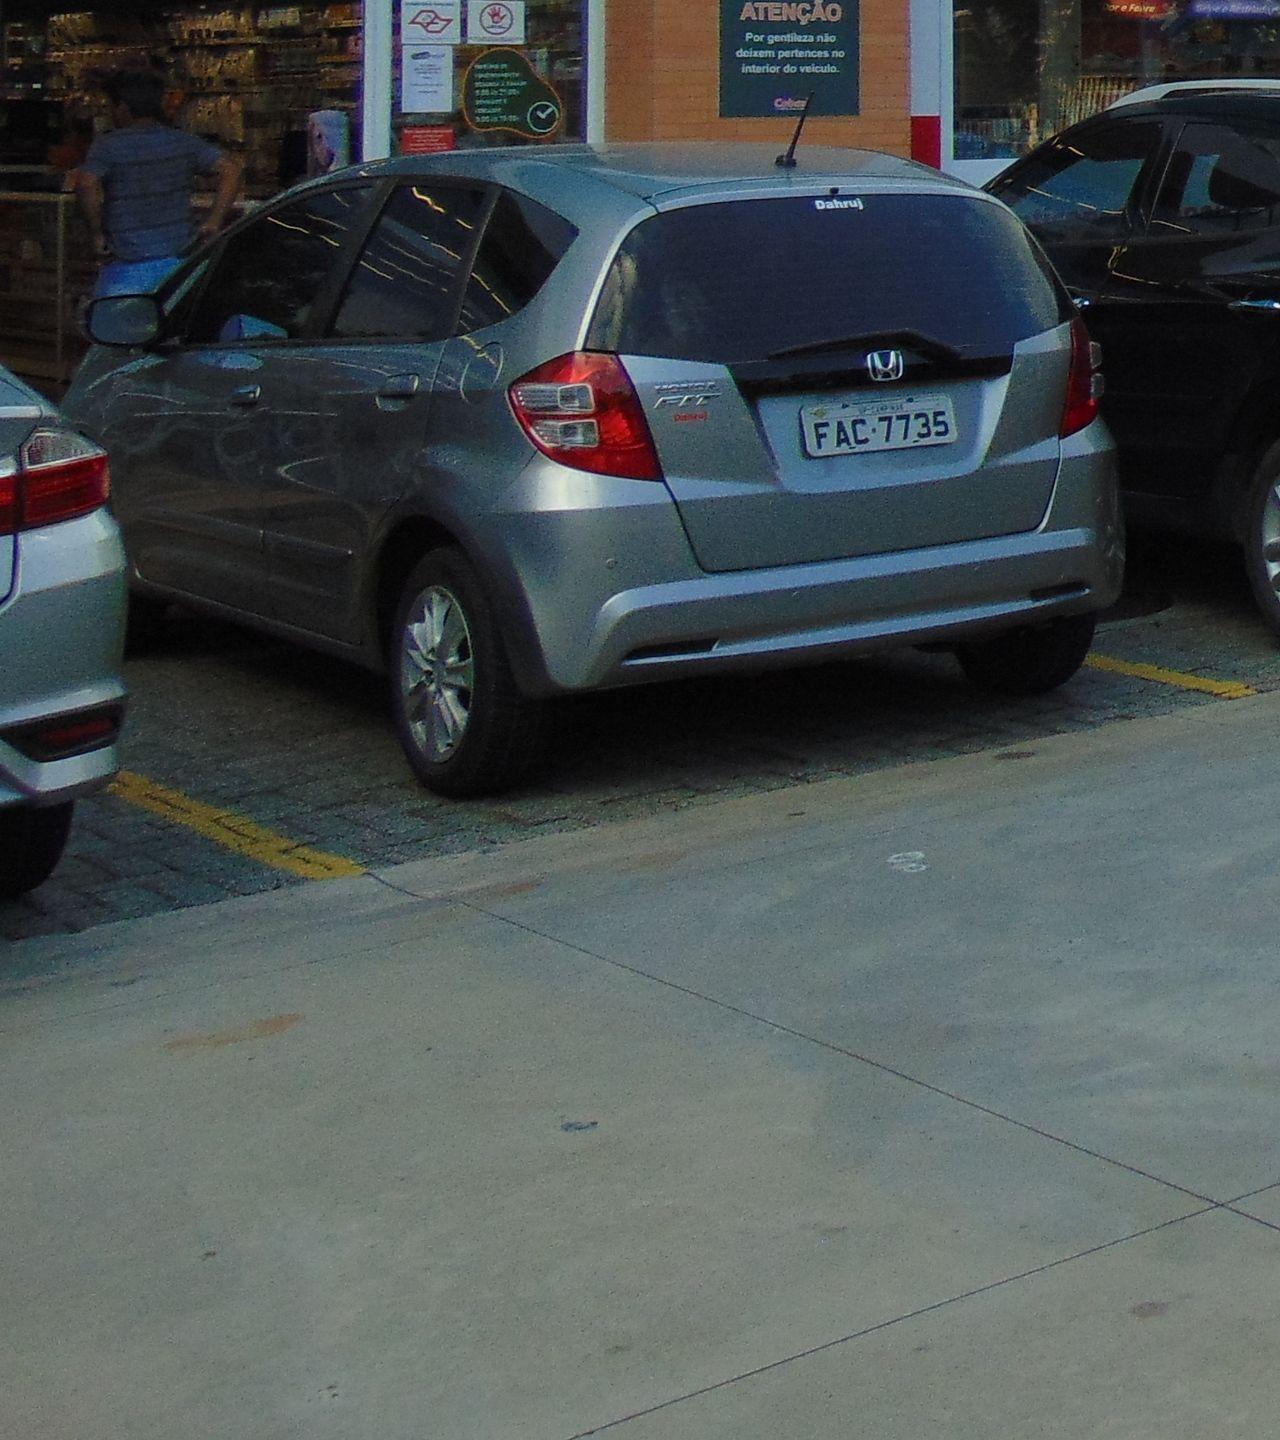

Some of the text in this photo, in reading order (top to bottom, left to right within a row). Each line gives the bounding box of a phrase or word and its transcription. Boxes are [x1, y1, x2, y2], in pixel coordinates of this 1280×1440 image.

[740, 0, 842, 25] ATENÇÃO
[745, 32, 836, 44] Por gentileza não
[736, 47, 845, 59] deixem pertences no
[741, 63, 780, 73] interior
[783, 63, 797, 73] do
[814, 197, 863, 210] Dahruj
